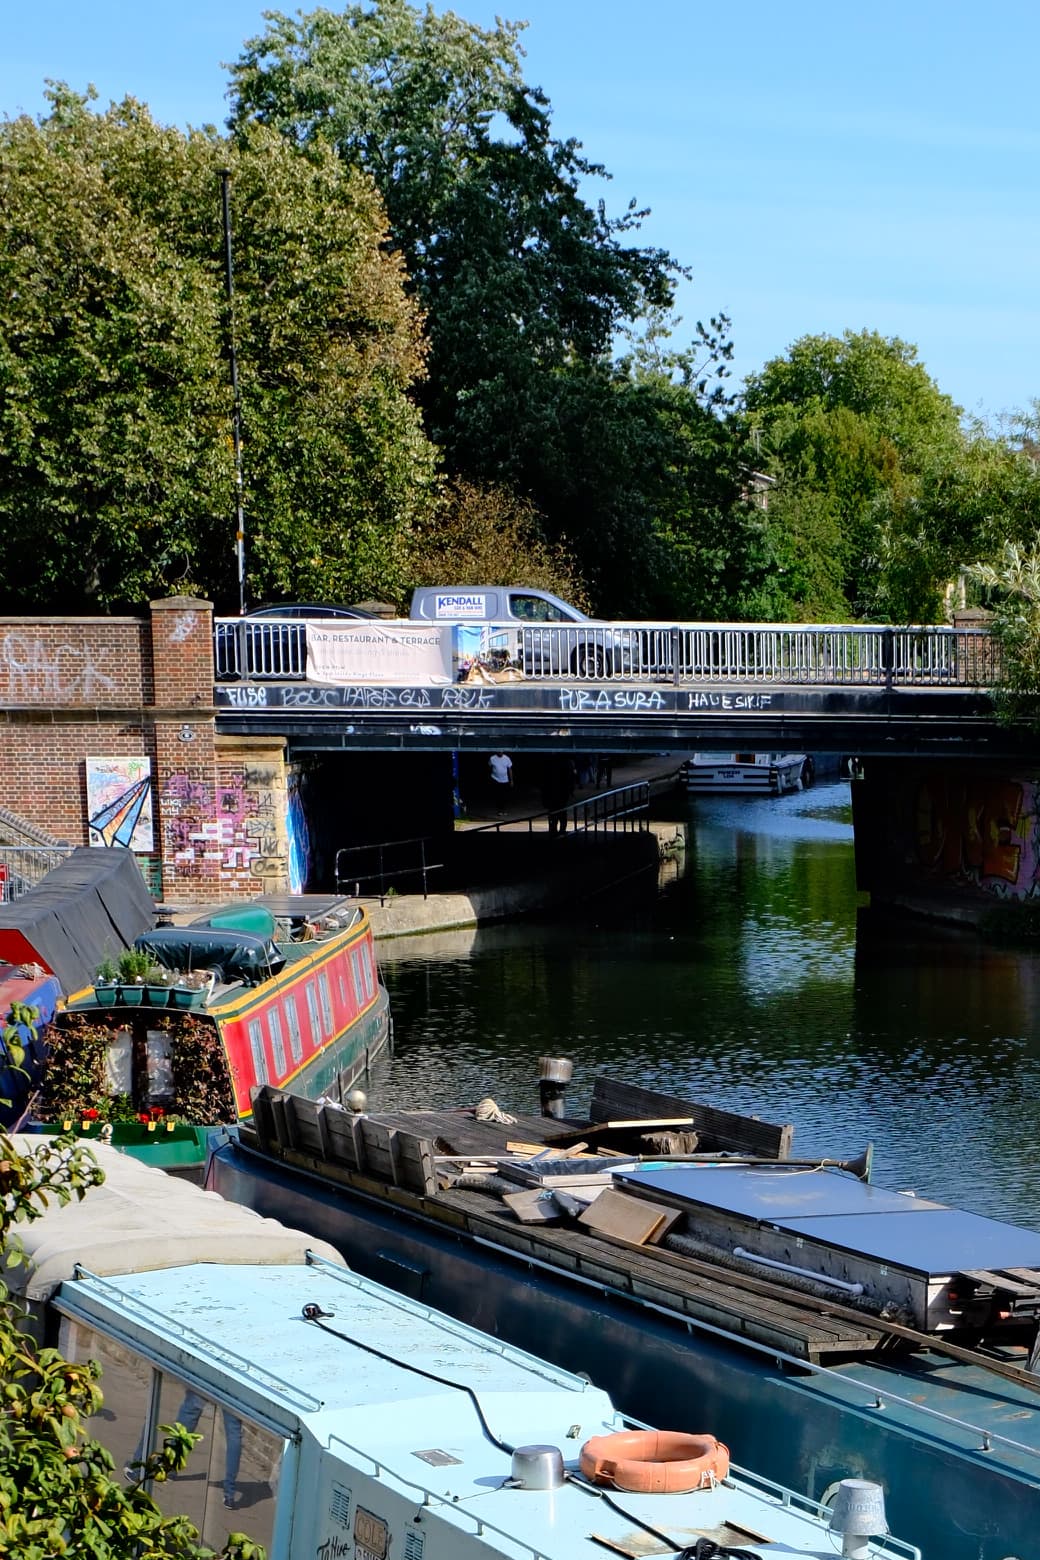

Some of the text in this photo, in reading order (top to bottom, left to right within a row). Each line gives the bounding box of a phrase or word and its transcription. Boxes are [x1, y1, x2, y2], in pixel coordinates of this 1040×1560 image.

[438, 596, 483, 609] KENDALL
[332, 634, 389, 644] RESTAURANT
[401, 636, 441, 645] TERRACE
